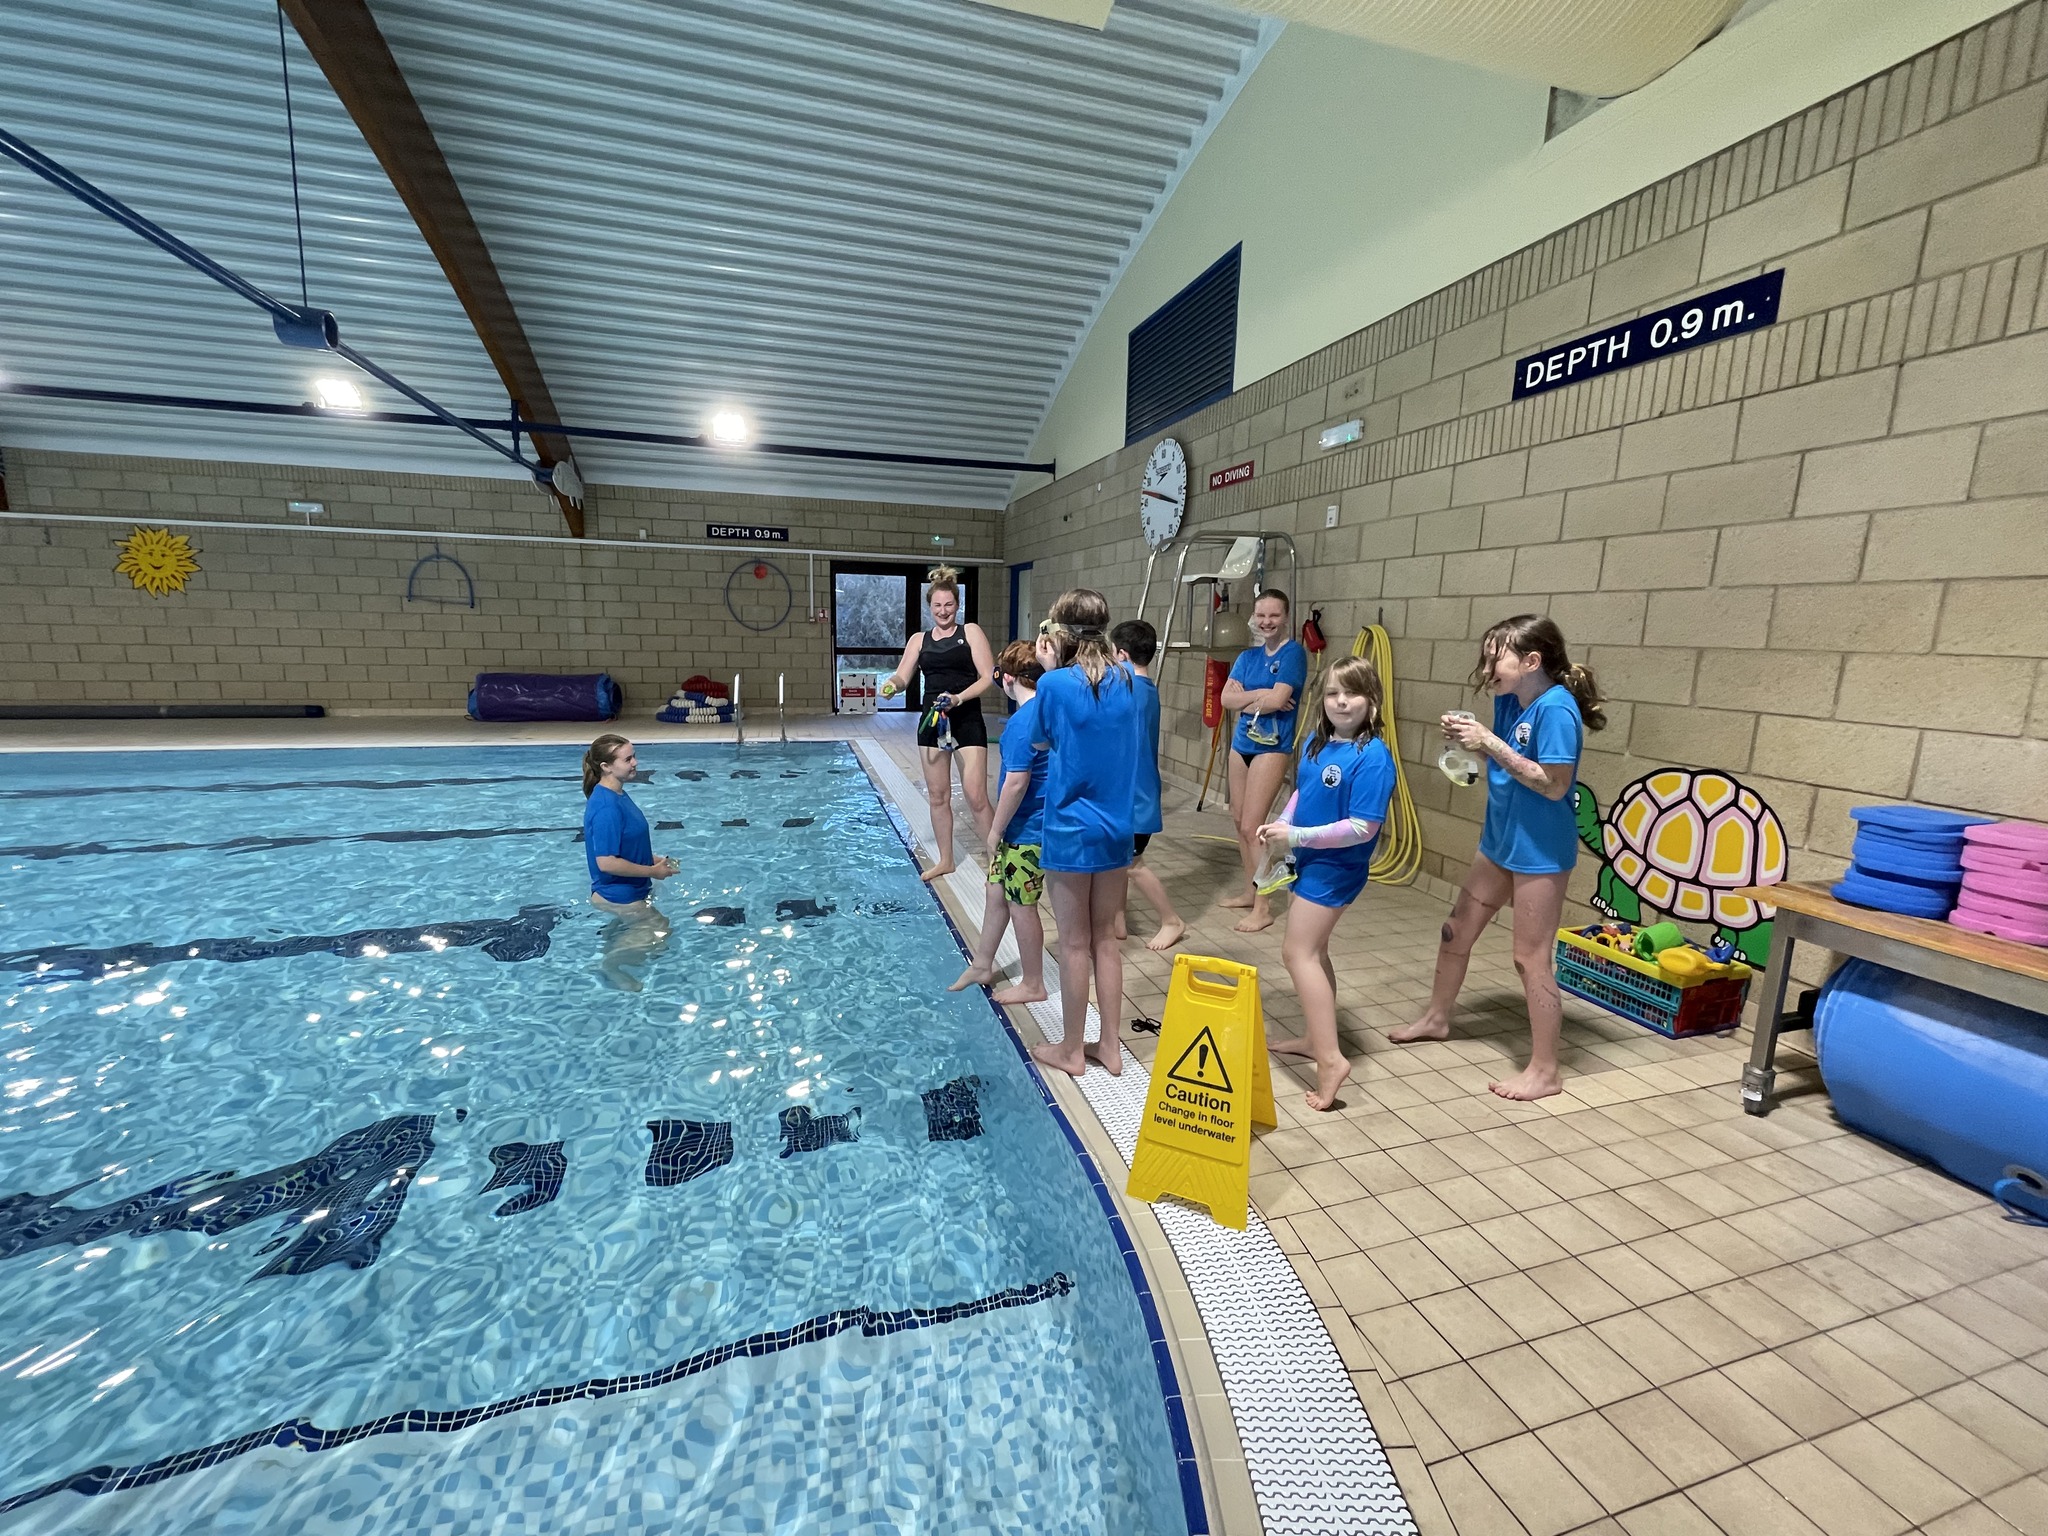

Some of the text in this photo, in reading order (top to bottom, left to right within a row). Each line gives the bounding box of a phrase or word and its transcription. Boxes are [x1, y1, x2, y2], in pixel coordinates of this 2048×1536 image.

[1525, 330, 1631, 388] DEPTH
[1212, 465, 1250, 487] NO DIVING
[711, 526, 750, 538] DEPTH
[1165, 1083, 1231, 1113] Caution
[1153, 1113, 1236, 1143] level underwater
[1158, 1101, 1235, 1129] Change in floor
